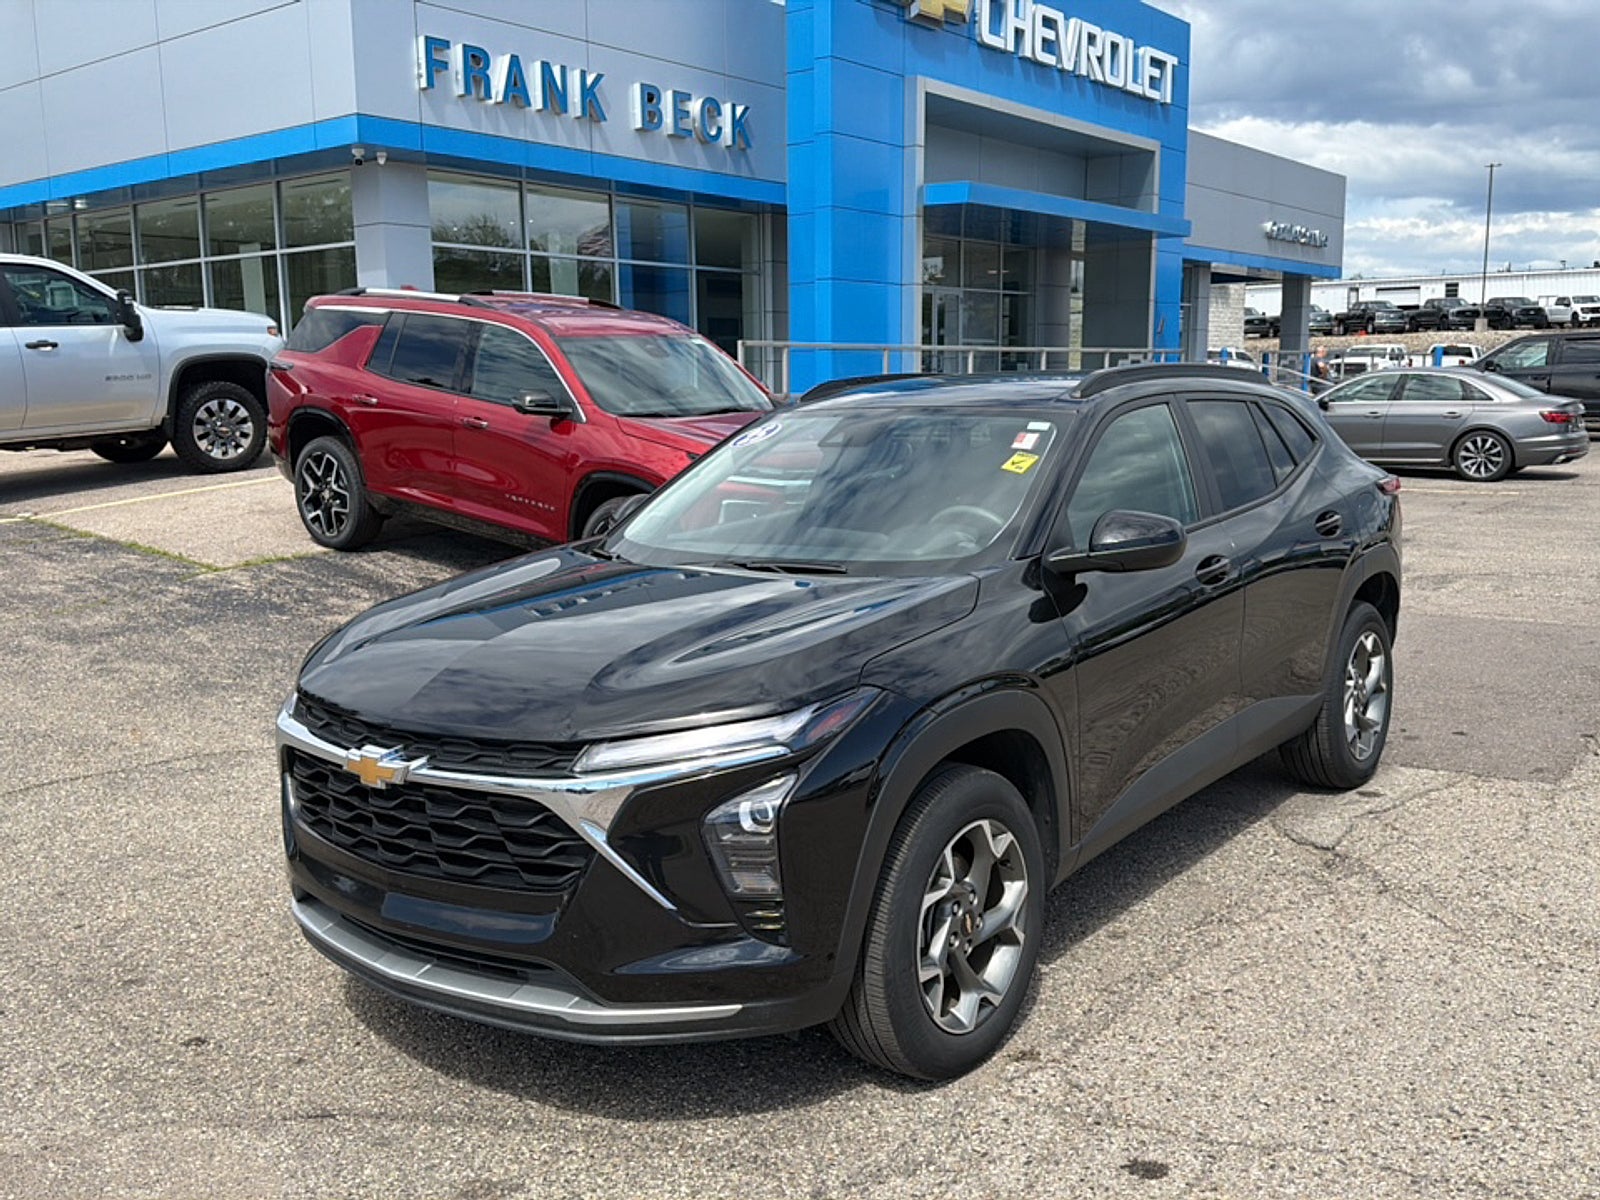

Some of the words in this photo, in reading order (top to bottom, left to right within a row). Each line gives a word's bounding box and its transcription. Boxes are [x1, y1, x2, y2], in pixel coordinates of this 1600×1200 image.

[419, 35, 607, 122] FRANK
[631, 82, 752, 150] BECK
[975, 0, 1178, 104] CHEVROLET
